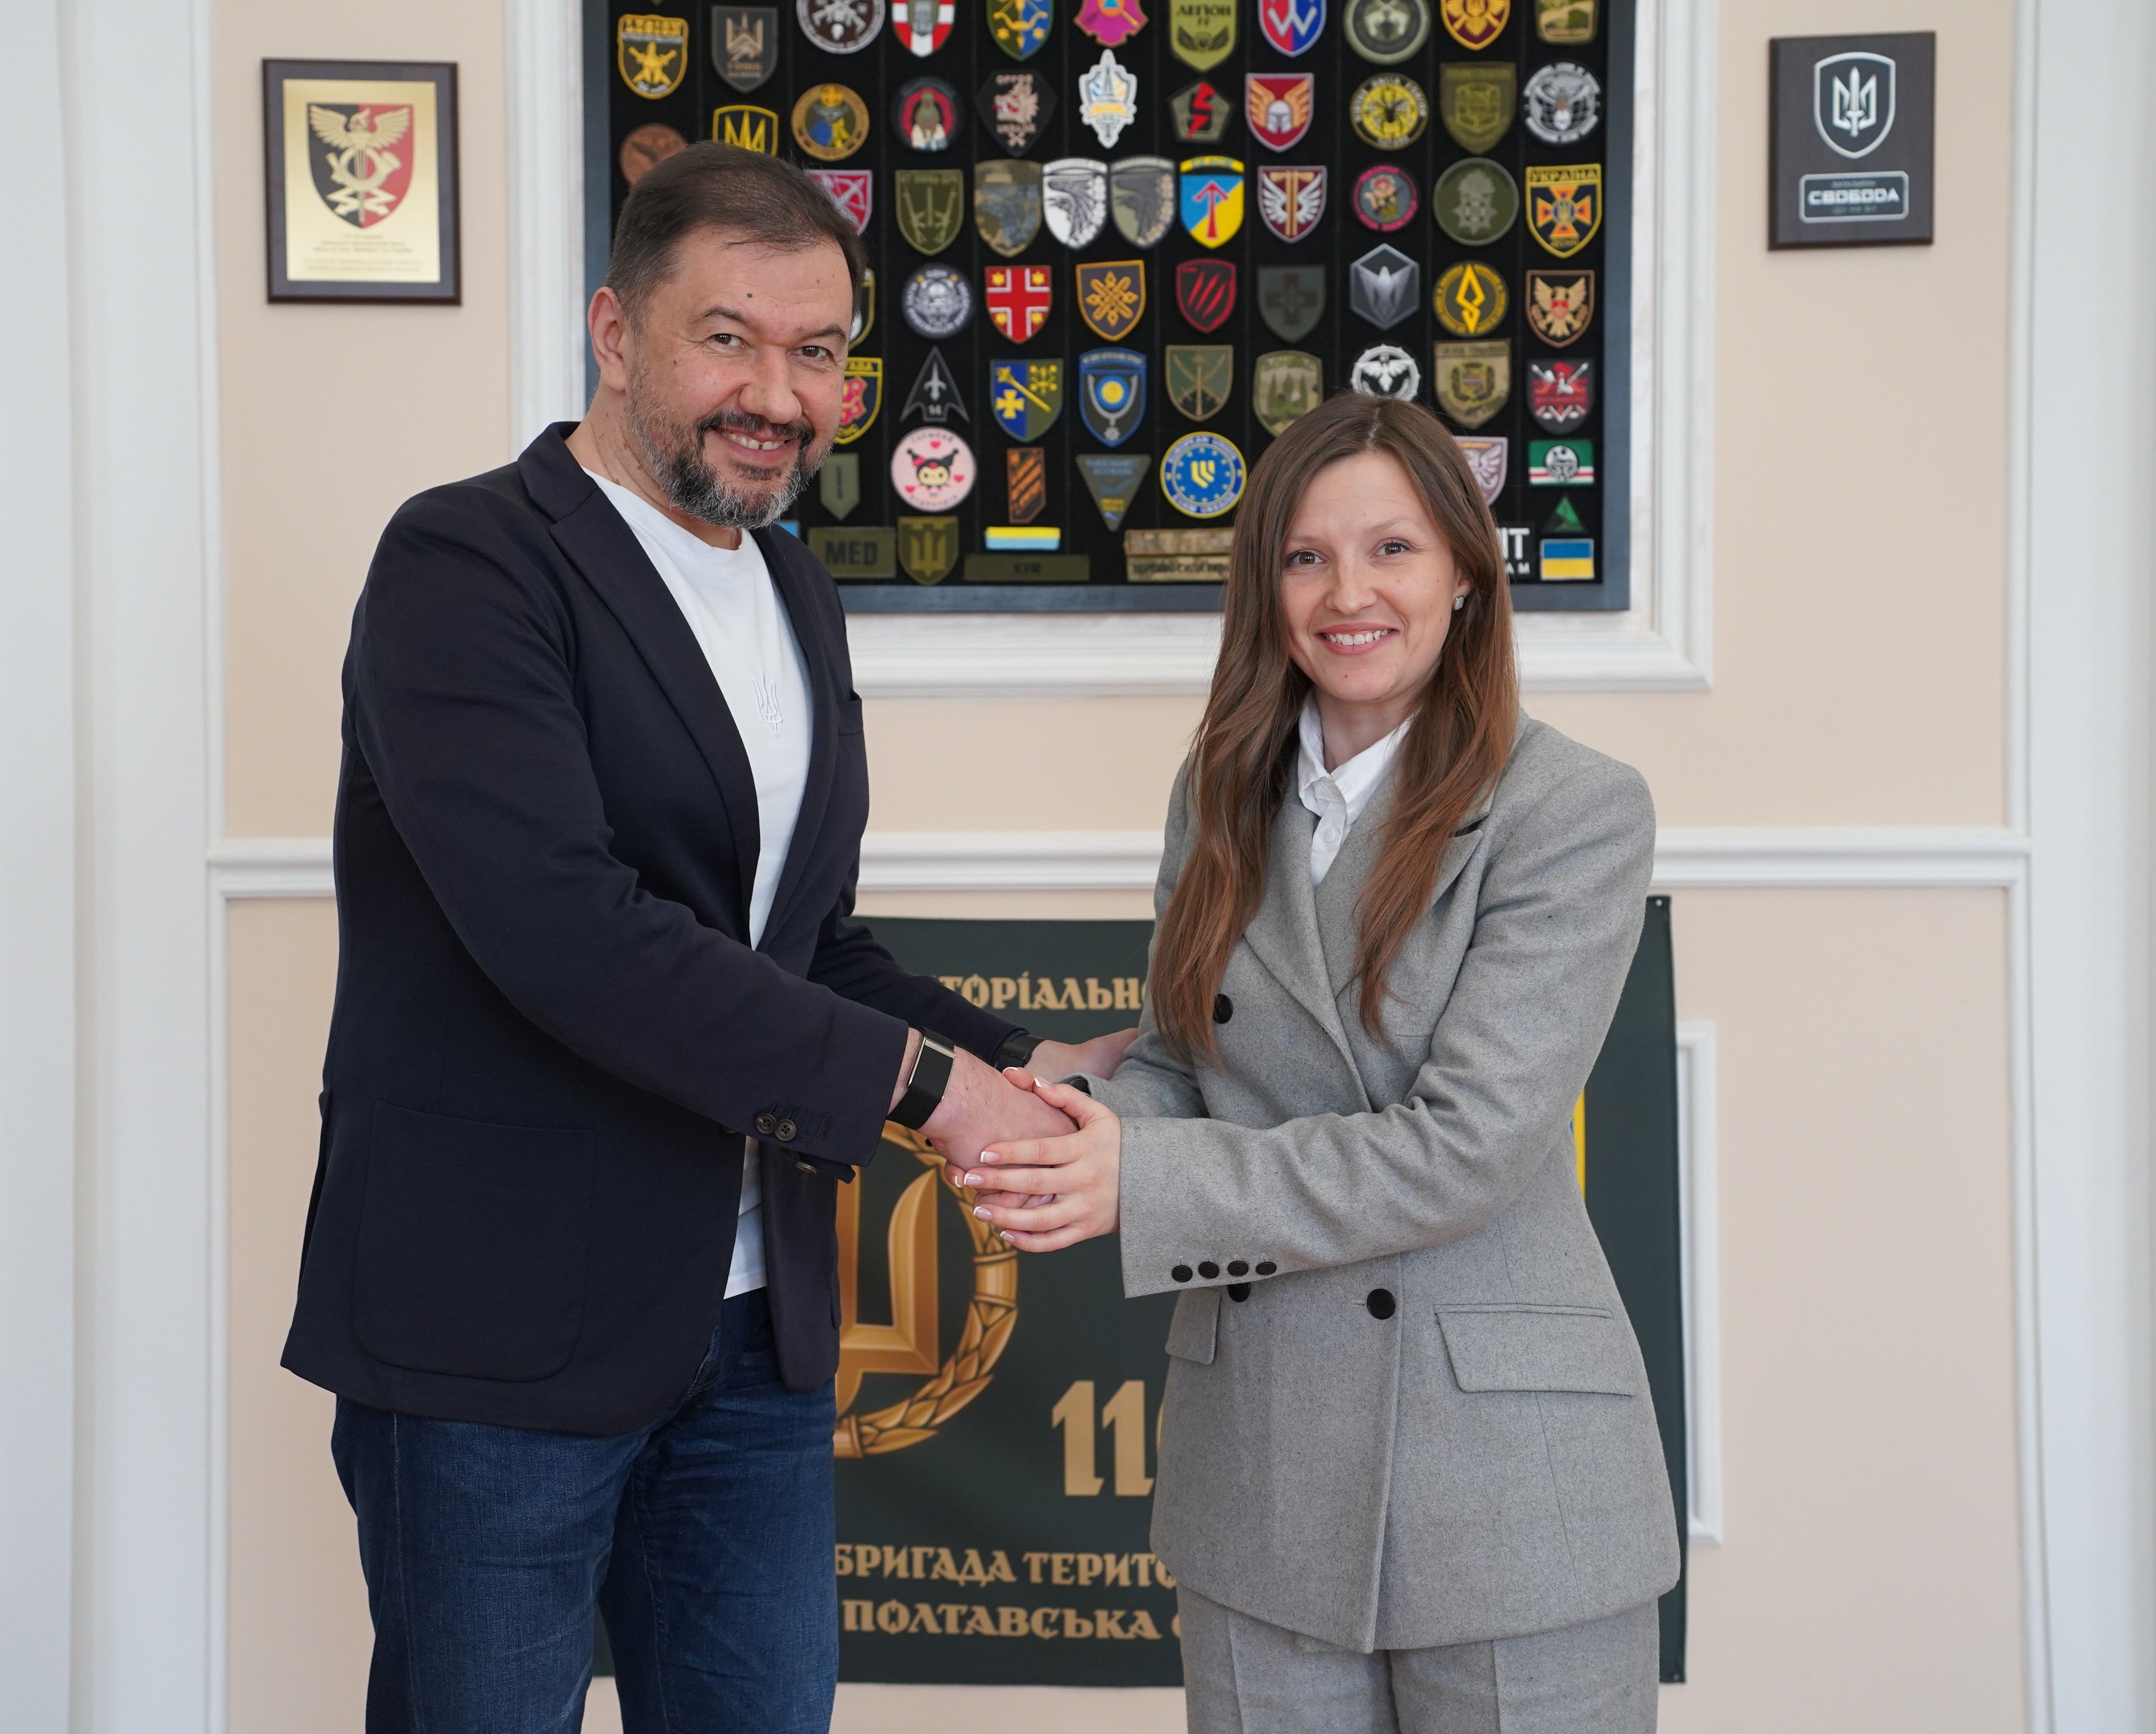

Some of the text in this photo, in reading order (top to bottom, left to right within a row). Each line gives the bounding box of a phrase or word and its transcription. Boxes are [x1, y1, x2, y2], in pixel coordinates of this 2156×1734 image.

[1807, 187, 1900, 205] СВОБОДА
[825, 541, 878, 565] MED
[1496, 527, 1530, 560] IT
[1051, 1380, 1164, 1496] 11
[835, 1543, 1018, 1587] БРИГАДА
[841, 1599, 1163, 1640] ПОЛТАВСЬКА
